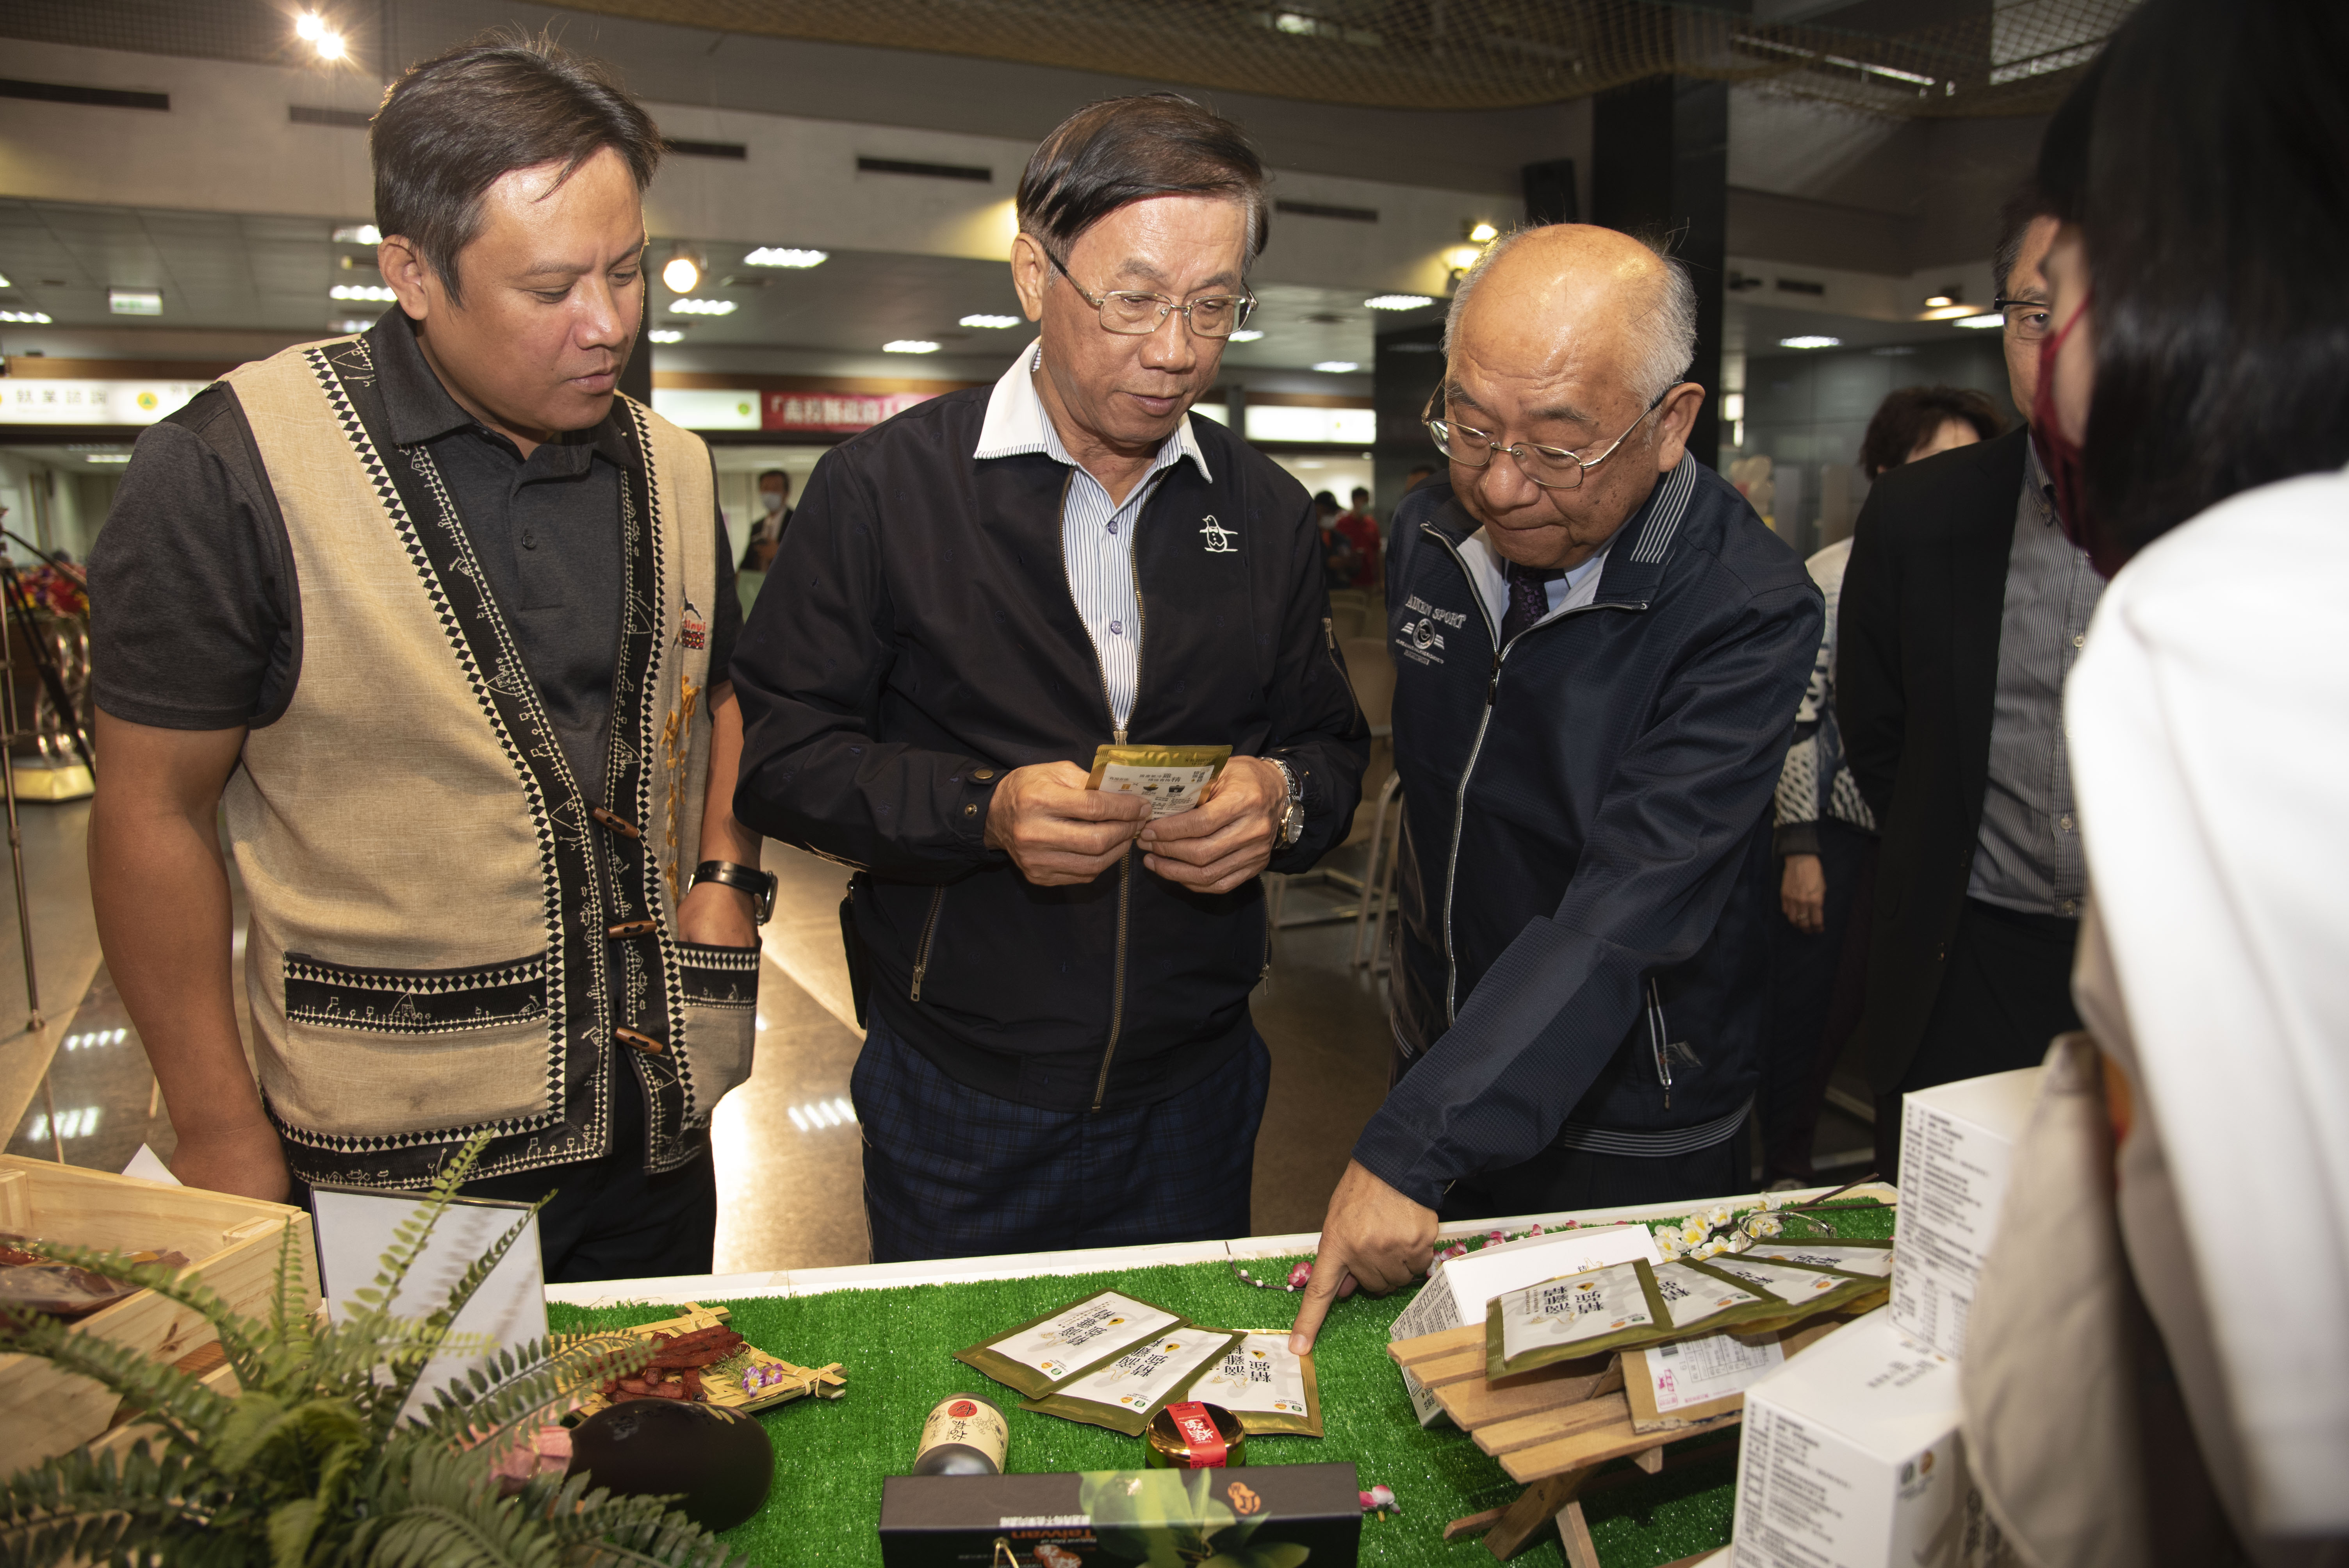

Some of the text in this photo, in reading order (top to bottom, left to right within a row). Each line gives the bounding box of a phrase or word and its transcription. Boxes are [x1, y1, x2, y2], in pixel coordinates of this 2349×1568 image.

[1405, 593, 1467, 629] AIKEN SPORT
[1543, 1286, 1571, 1315] 滴雞精
[1575, 1290, 1604, 1315] 精強
[1058, 1308, 1116, 1338] 滴雞精
[1065, 1326, 1107, 1347] 精強
[1130, 1354, 1169, 1377] 精強
[1249, 1360, 1272, 1383] 精強
[1011, 1529, 1097, 1540] Taiwan
